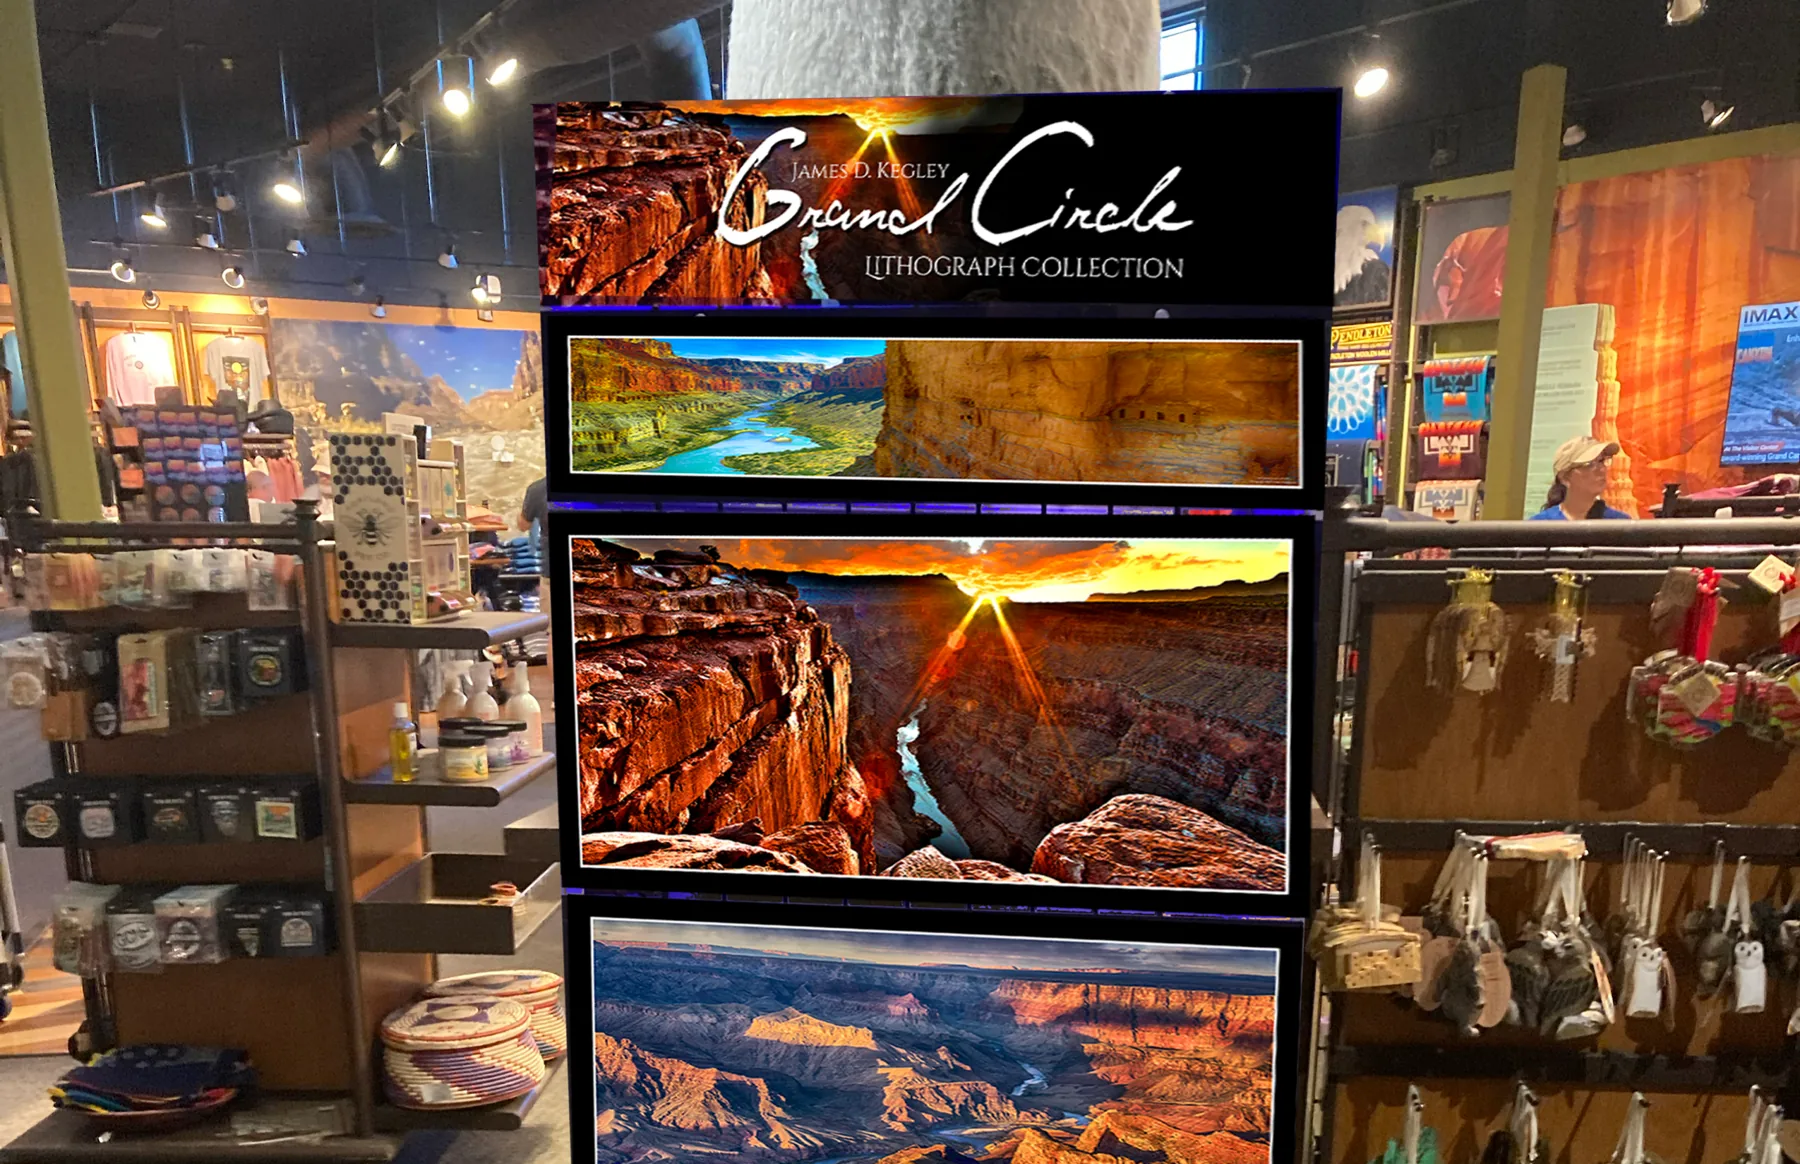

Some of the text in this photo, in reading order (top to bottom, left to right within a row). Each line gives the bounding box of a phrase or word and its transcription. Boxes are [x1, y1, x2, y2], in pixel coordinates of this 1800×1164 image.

[791, 161, 950, 182] JAMES D. KEGLEY
[714, 120, 1195, 247] Grand Circle
[864, 255, 1185, 281] LITHOGRAPH COLLECTION
[1743, 306, 1799, 324] IMAX
[1331, 325, 1392, 343] PENDLETON
